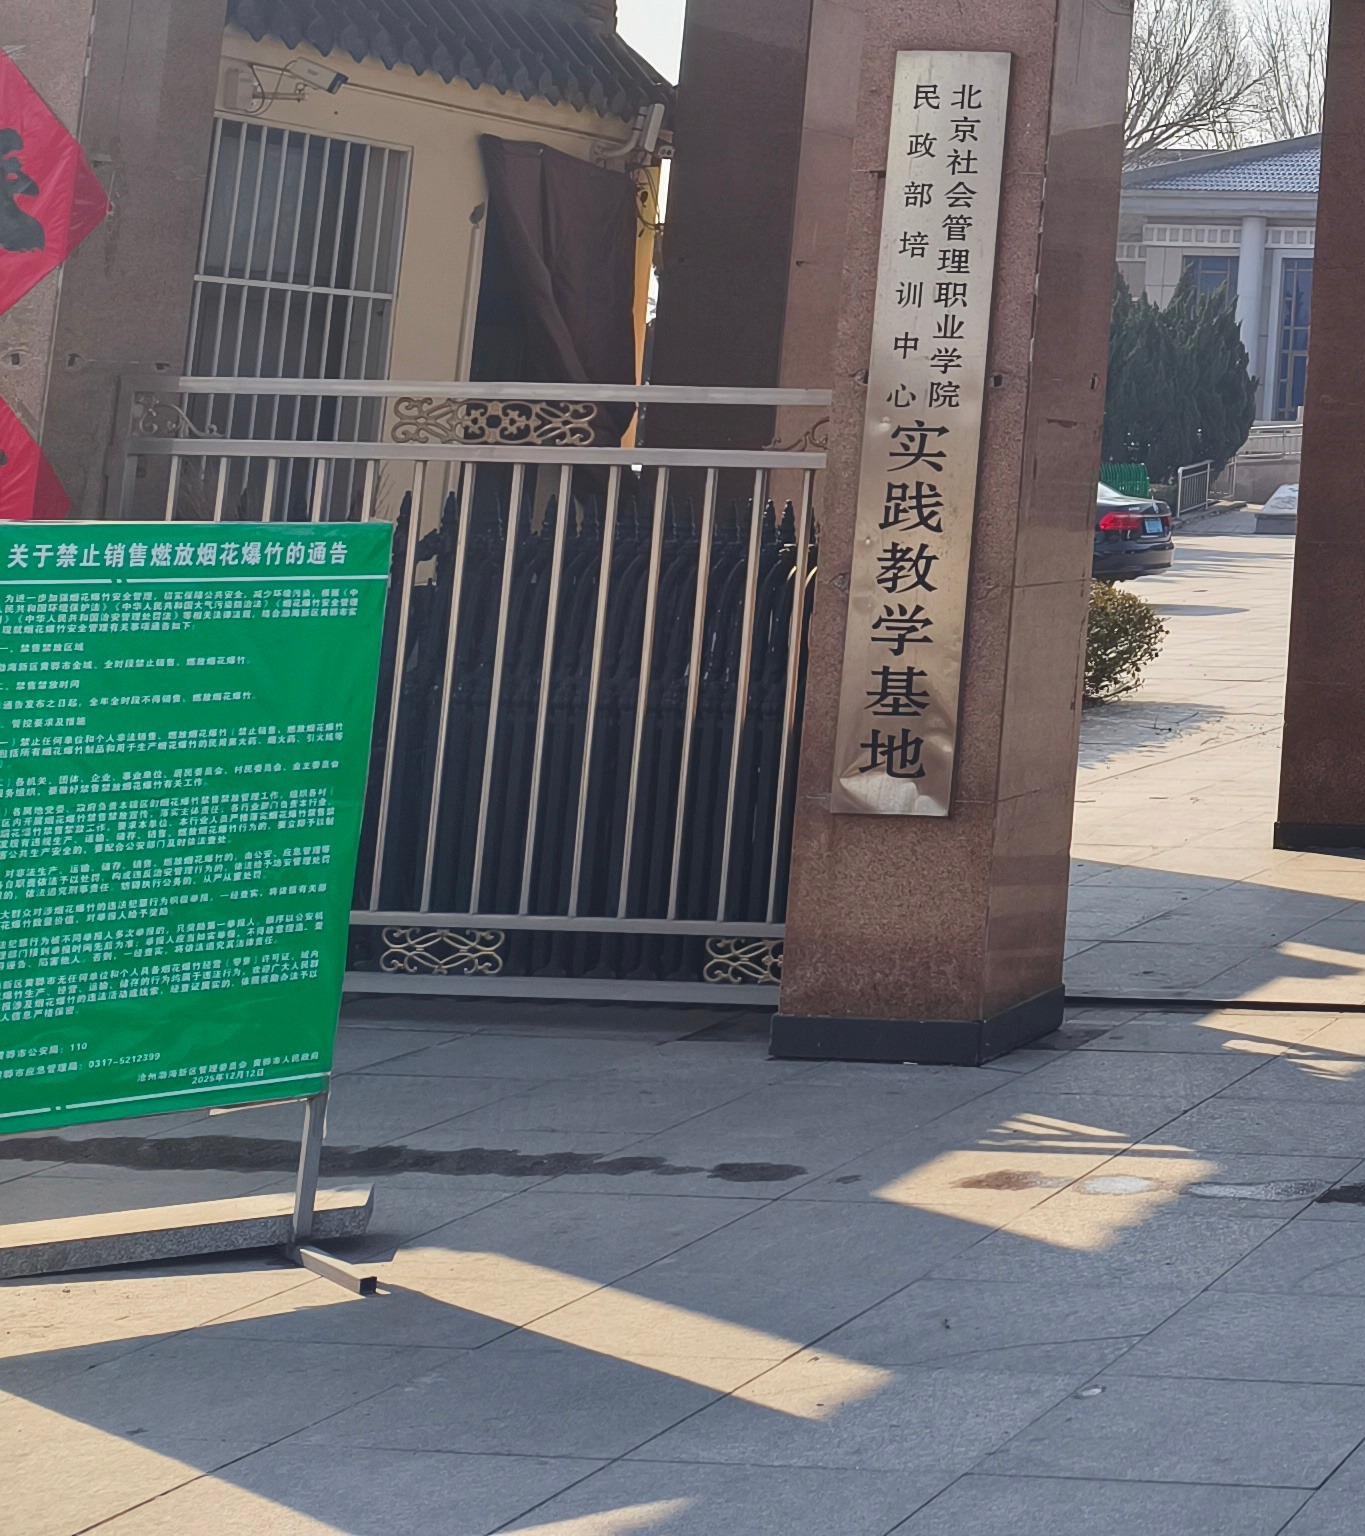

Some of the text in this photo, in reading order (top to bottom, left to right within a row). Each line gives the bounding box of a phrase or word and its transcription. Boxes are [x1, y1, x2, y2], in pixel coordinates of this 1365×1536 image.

[886, 83, 941, 409] 民政部培训中心
[929, 83, 983, 409] 北京社会管理职业学院
[8, 541, 348, 568] 关于禁止销售燃放烟花爆竹的通告
[858, 419, 950, 779] 实践教学基地
